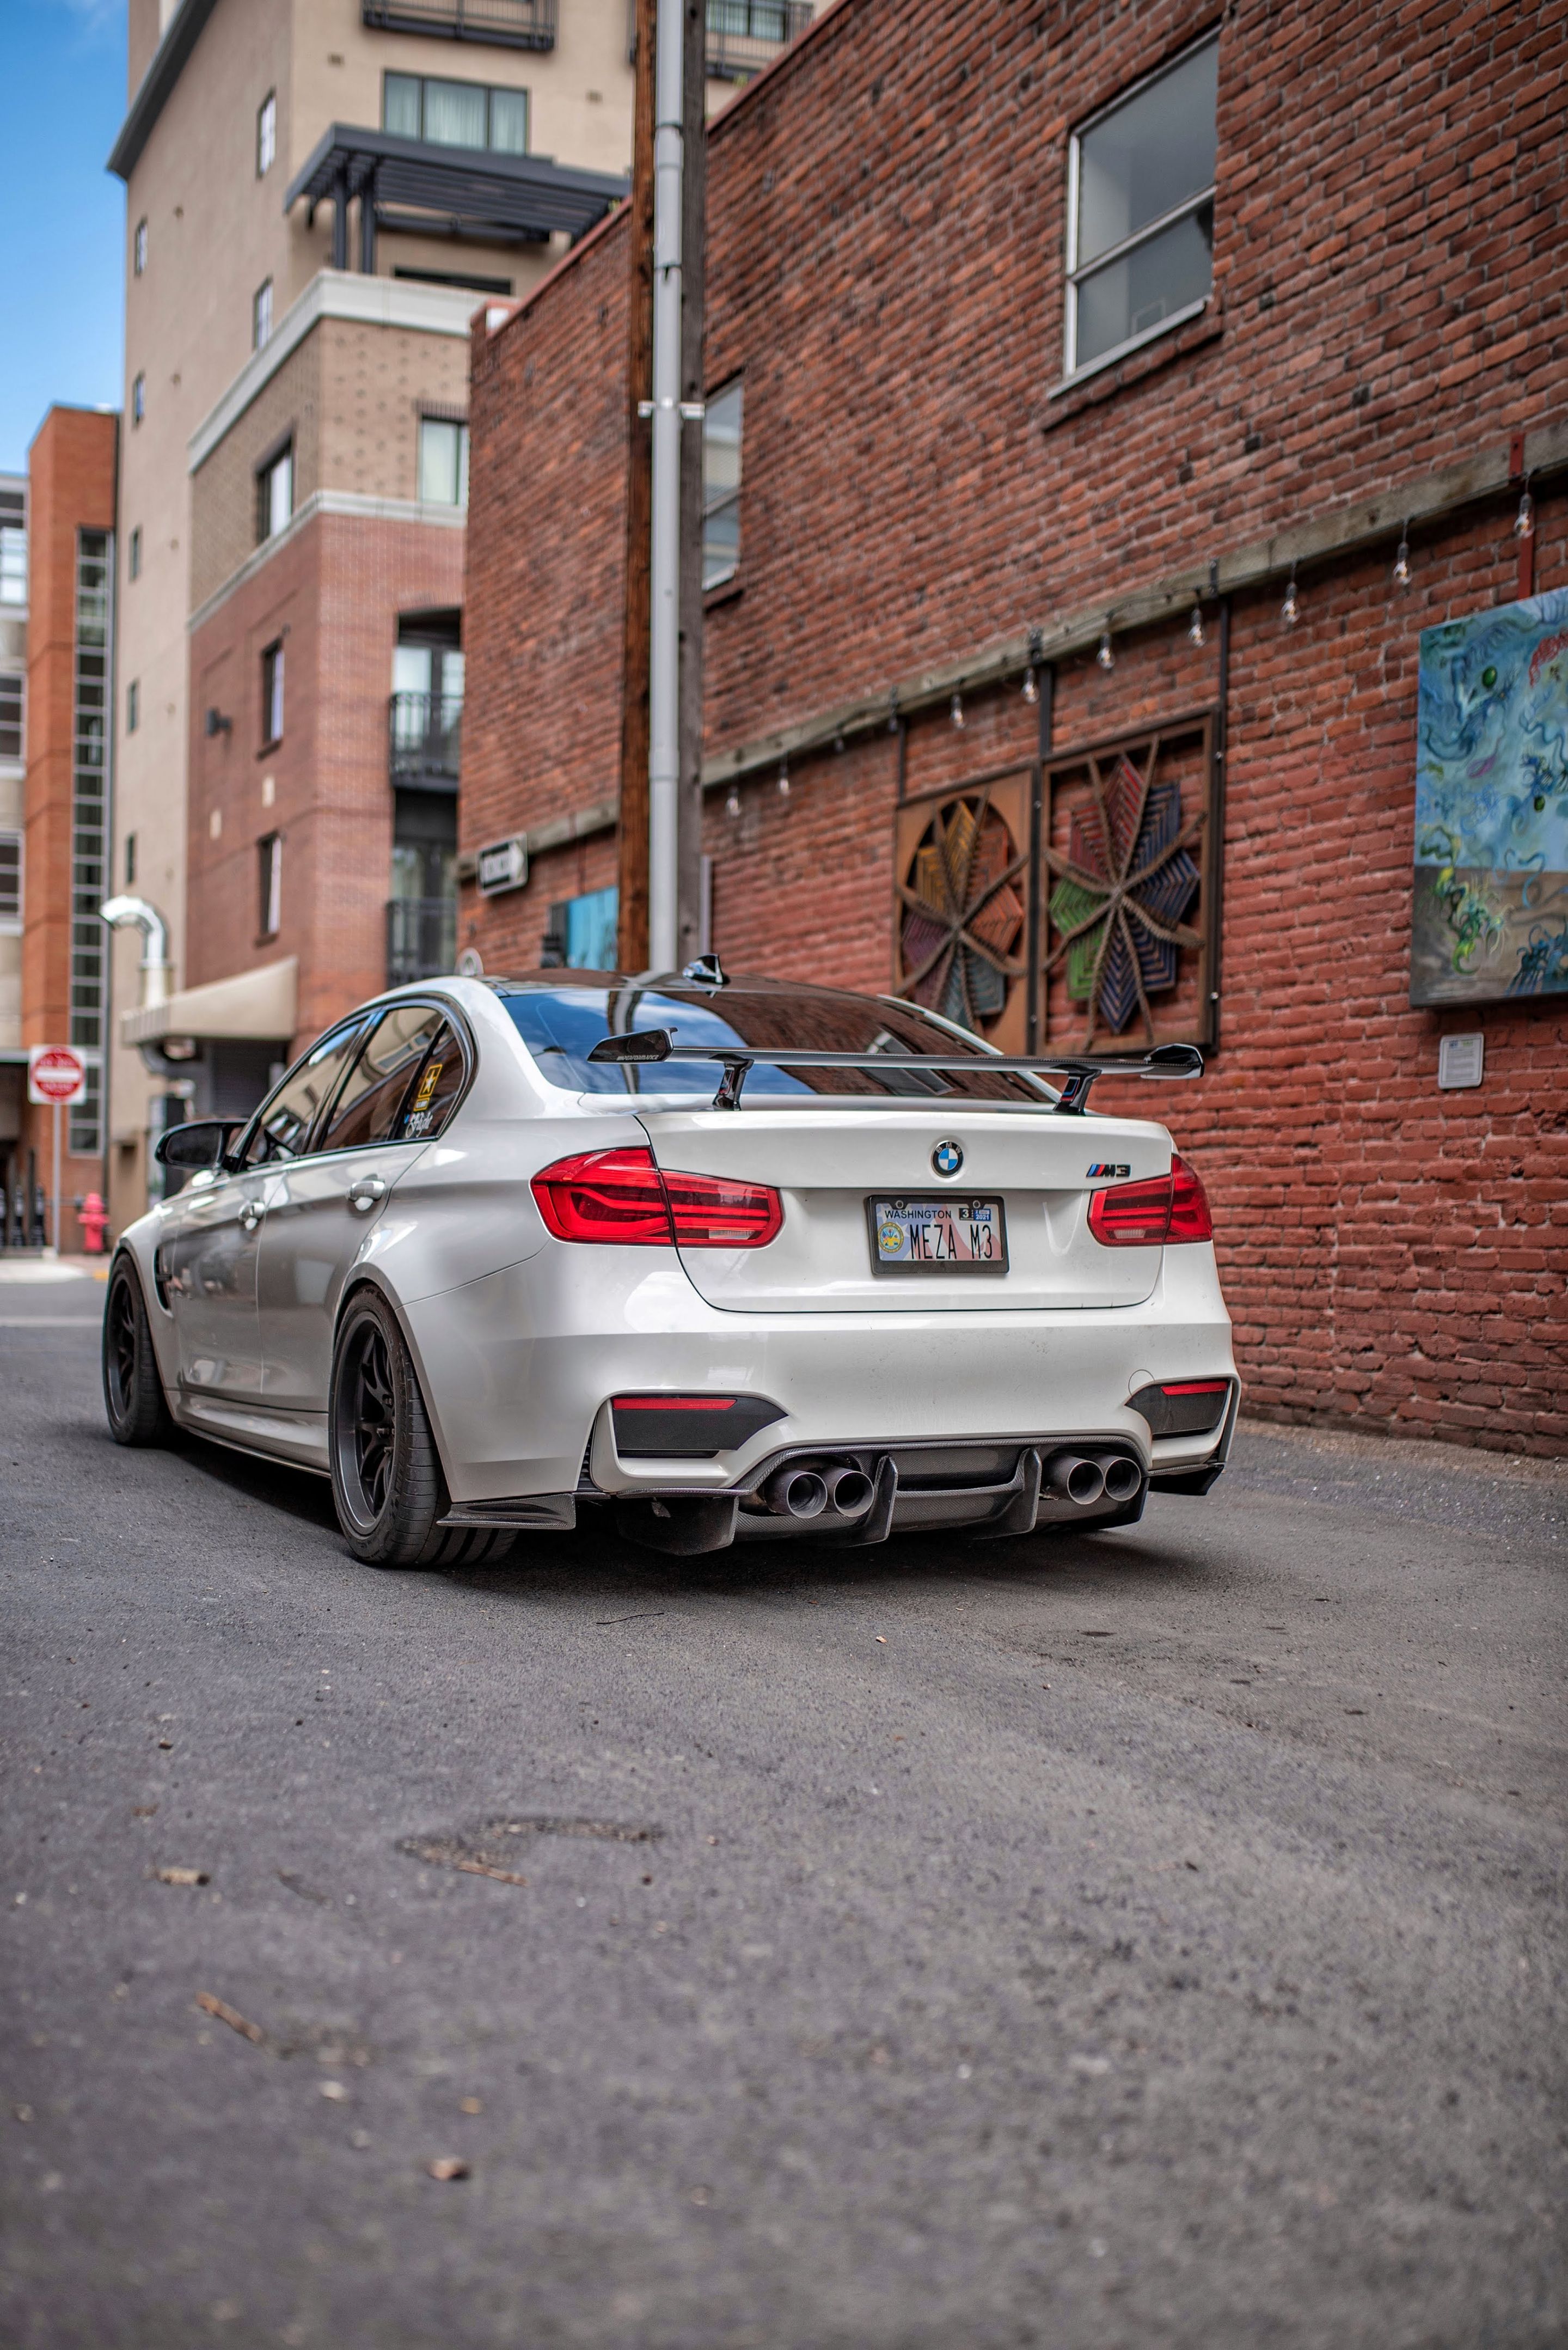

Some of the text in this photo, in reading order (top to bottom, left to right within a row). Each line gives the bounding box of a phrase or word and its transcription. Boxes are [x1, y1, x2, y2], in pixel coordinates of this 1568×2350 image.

[935, 1142, 962, 1153] BMW
[1100, 1164, 1131, 1177] M3
[885, 1210, 952, 1219] WASHINGTON
[963, 1209, 969, 1218] 3
[910, 1224, 957, 1259] MEZA
[970, 1224, 992, 1259] M3
